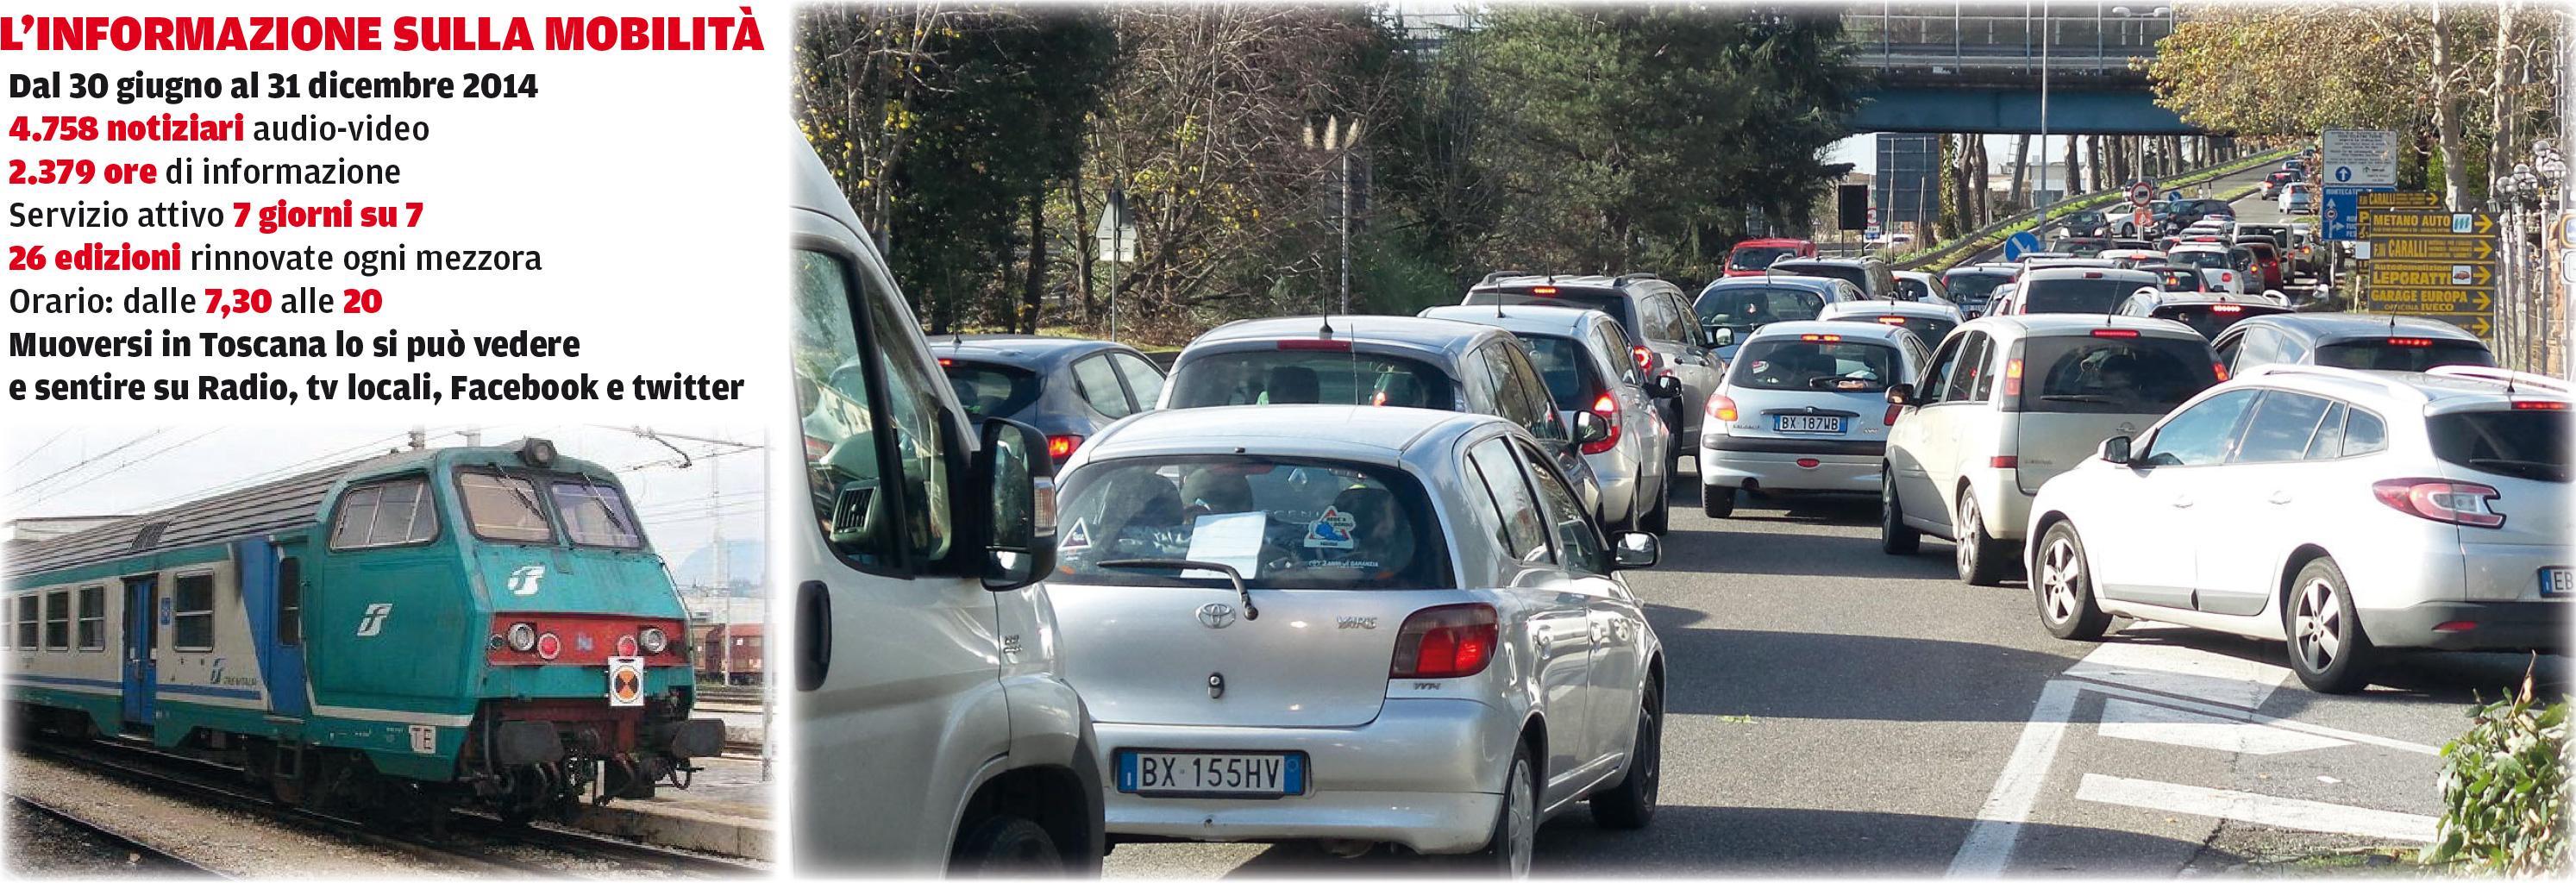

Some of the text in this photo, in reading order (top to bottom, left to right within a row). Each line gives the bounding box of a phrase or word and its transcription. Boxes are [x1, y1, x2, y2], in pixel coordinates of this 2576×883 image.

[2369, 192, 2396, 205] CARALLI
[2372, 215, 2451, 227] METANO AUTO
[2388, 239, 2428, 258] CARALLI
[2372, 271, 2452, 285] LEPORATTI
[2372, 290, 2468, 303] GARAGE EUROPA
[2421, 303, 2454, 311] IVECO
[1782, 416, 1797, 429] BX
[1802, 416, 1839, 430] 187WB
[411, 727, 433, 750] TE
[1142, 756, 1177, 787] BX
[1192, 757, 1280, 789] 155HV
